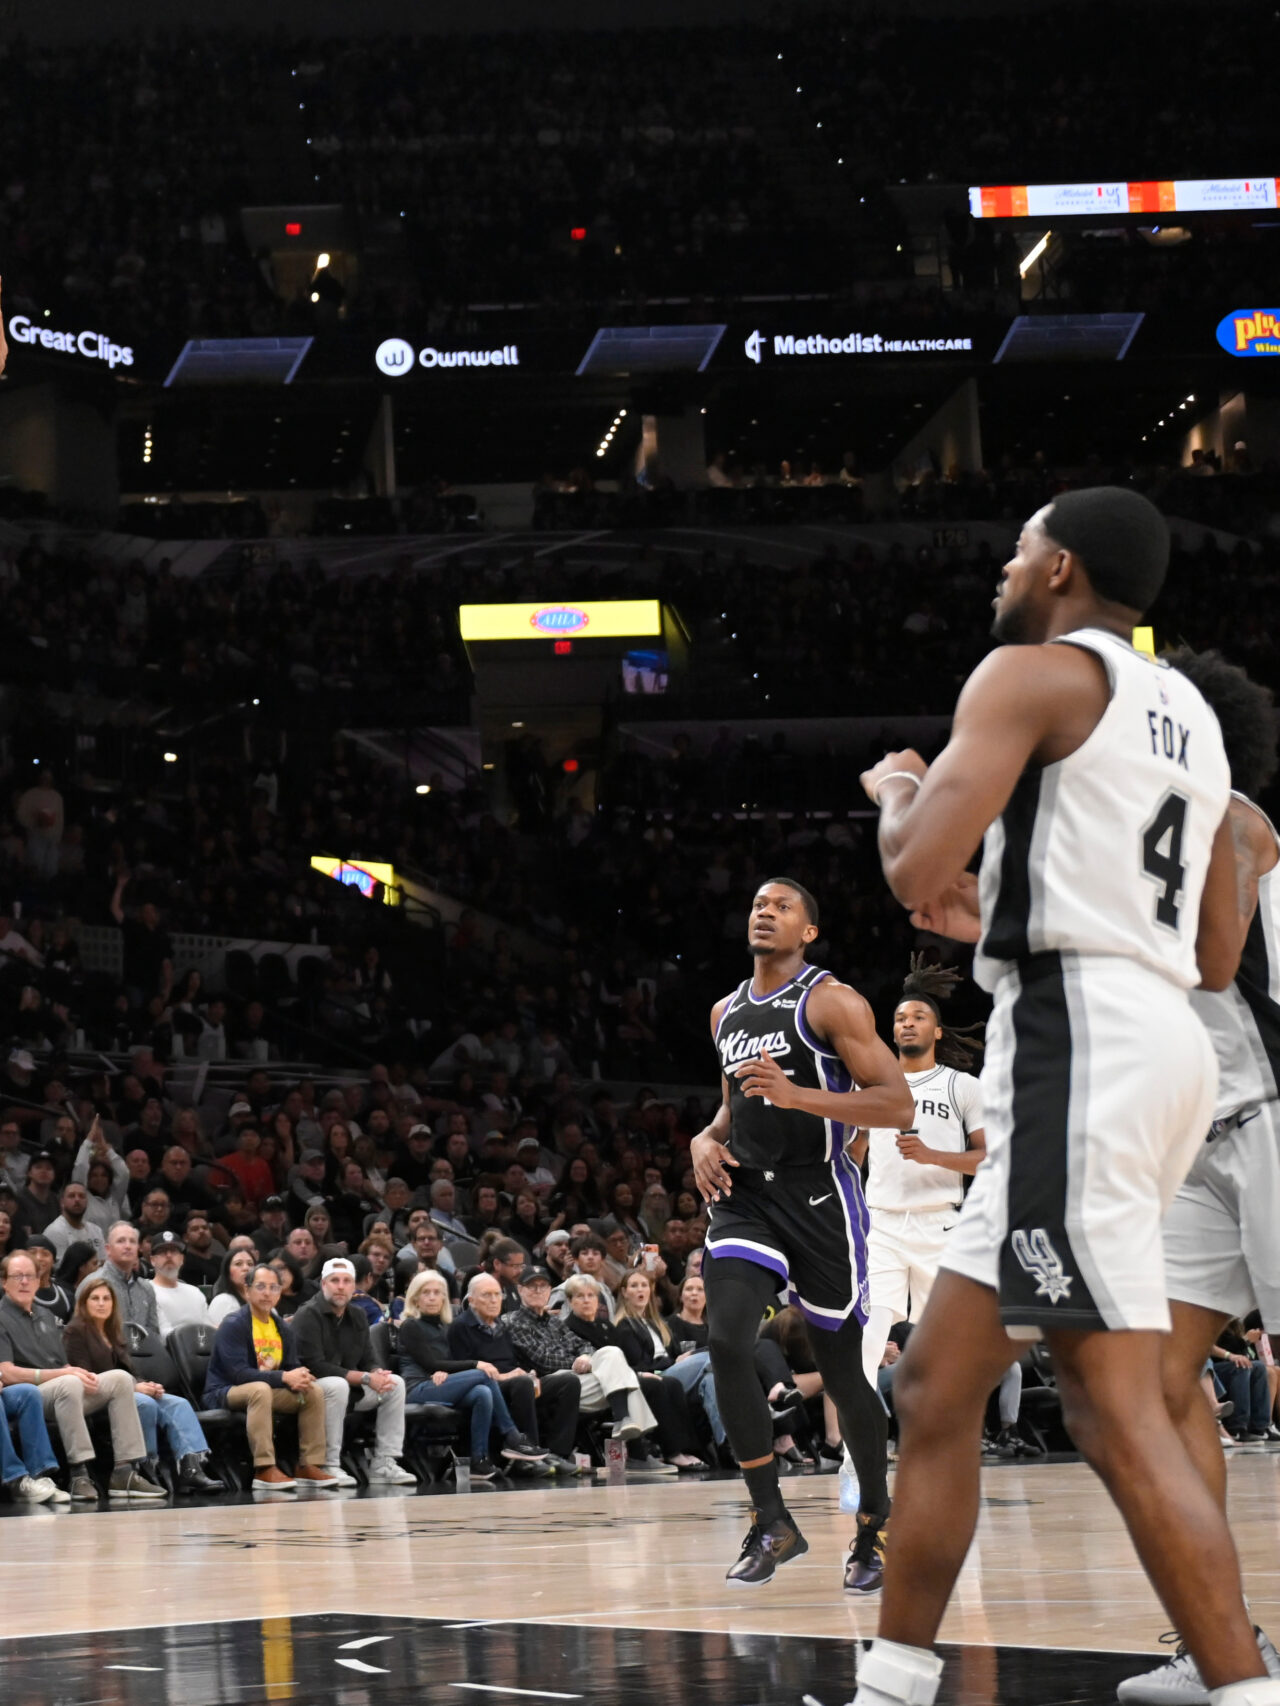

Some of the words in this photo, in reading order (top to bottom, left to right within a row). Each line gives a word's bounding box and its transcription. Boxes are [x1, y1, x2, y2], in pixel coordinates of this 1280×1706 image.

[9, 315, 77, 354] Great
[77, 331, 134, 369] Clips
[419, 345, 519, 368] Ownwell
[774, 333, 883, 355] Methodist
[884, 338, 972, 352] HEALTHCARE
[1147, 710, 1190, 772] FOX
[1140, 787, 1190, 937] 4
[719, 1029, 791, 1068] Kings
